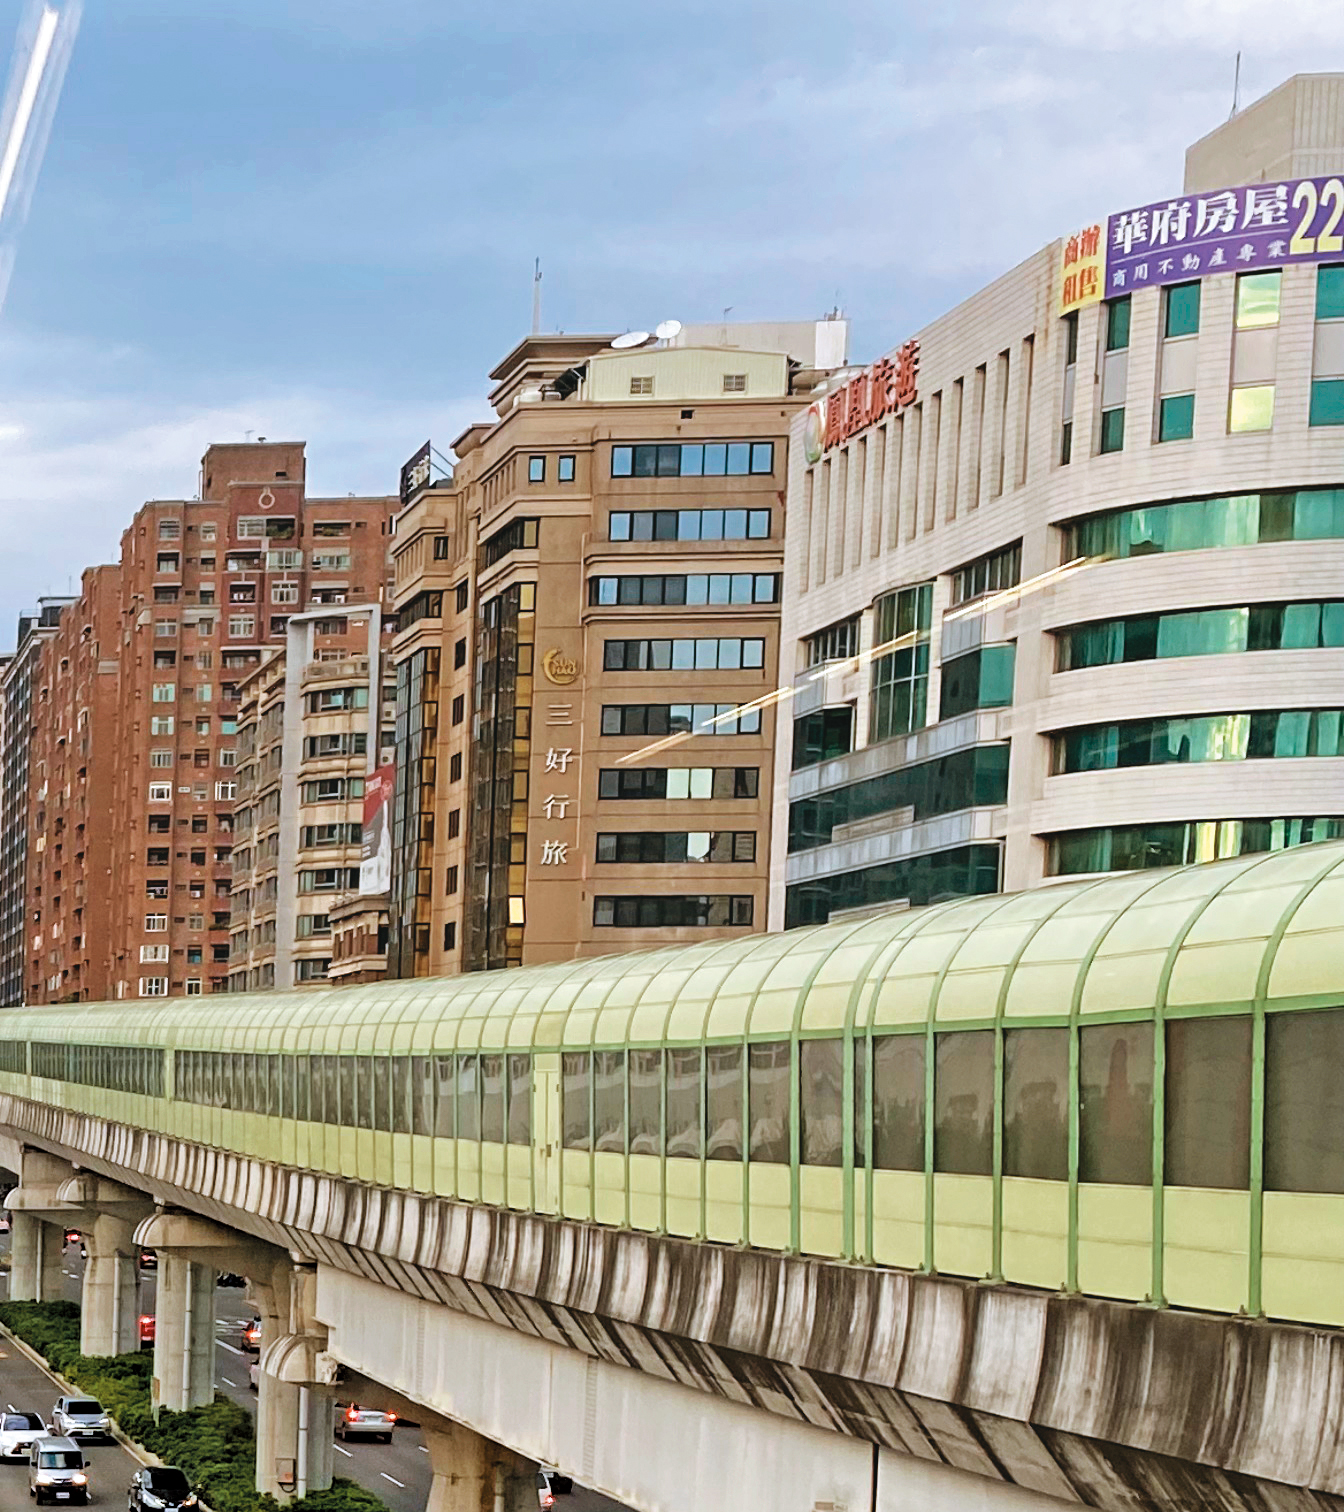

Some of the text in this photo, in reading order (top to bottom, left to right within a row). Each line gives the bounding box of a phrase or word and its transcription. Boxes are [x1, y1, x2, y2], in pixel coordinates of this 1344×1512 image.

[1112, 184, 1289, 254] 華府房屋
[1112, 240, 1287, 288] 商用不動產專業
[540, 703, 574, 866] 三好行旅
